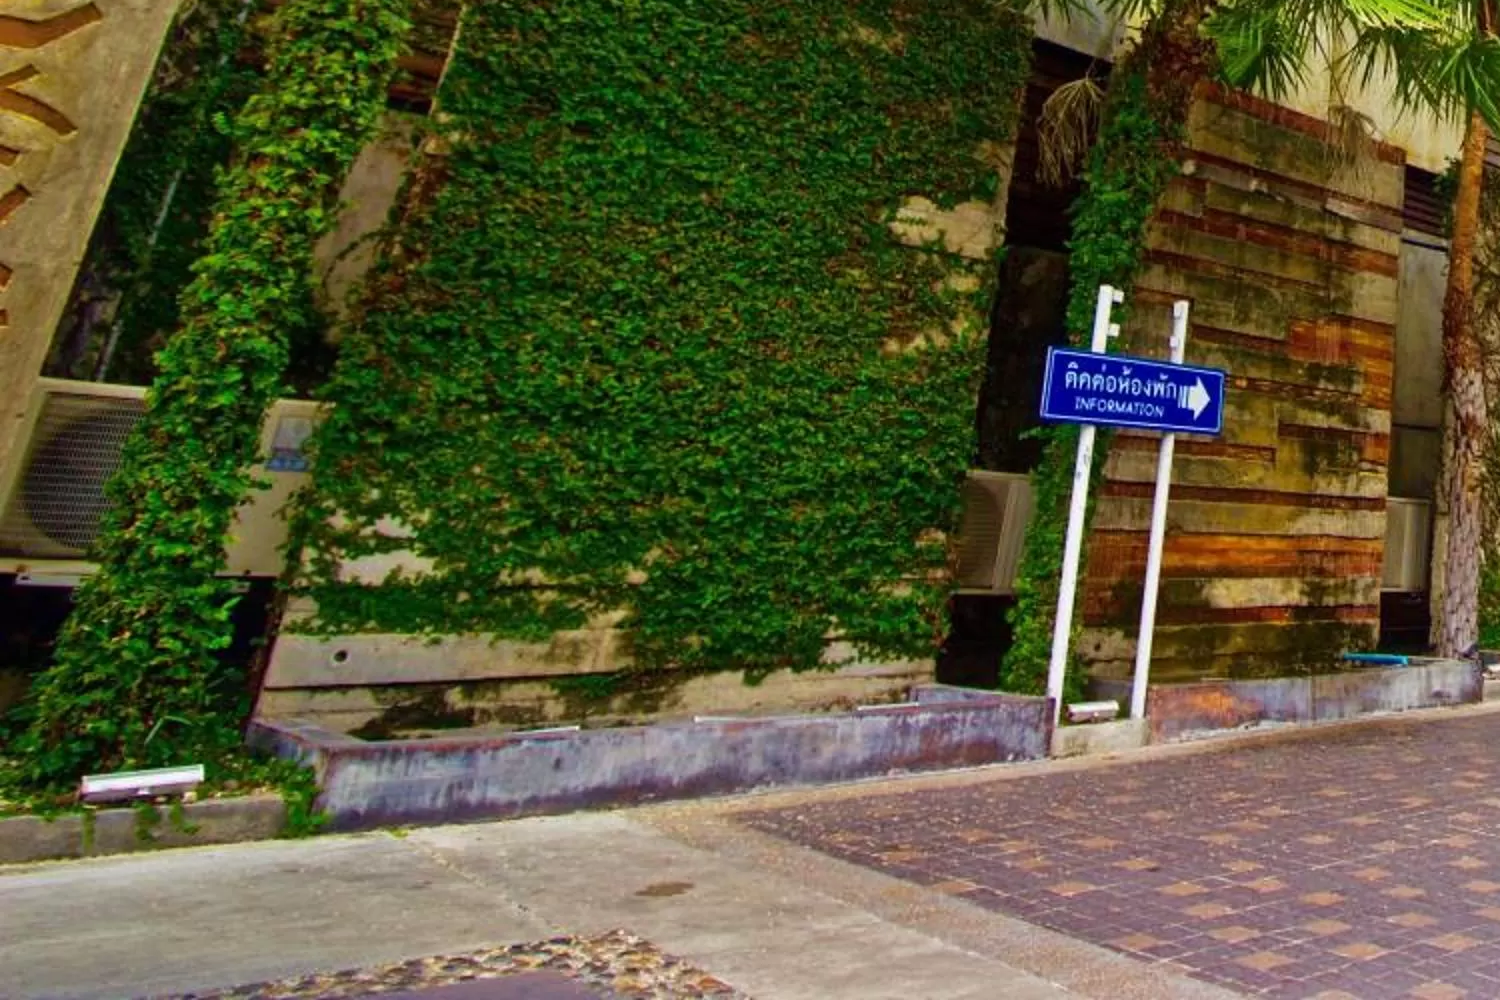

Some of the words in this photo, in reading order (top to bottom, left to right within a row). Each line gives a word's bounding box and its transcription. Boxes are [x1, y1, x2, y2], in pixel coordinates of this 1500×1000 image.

[1065, 361, 1177, 400] ติดต่อห้องพัก
[1074, 396, 1165, 418] INFORMATION
